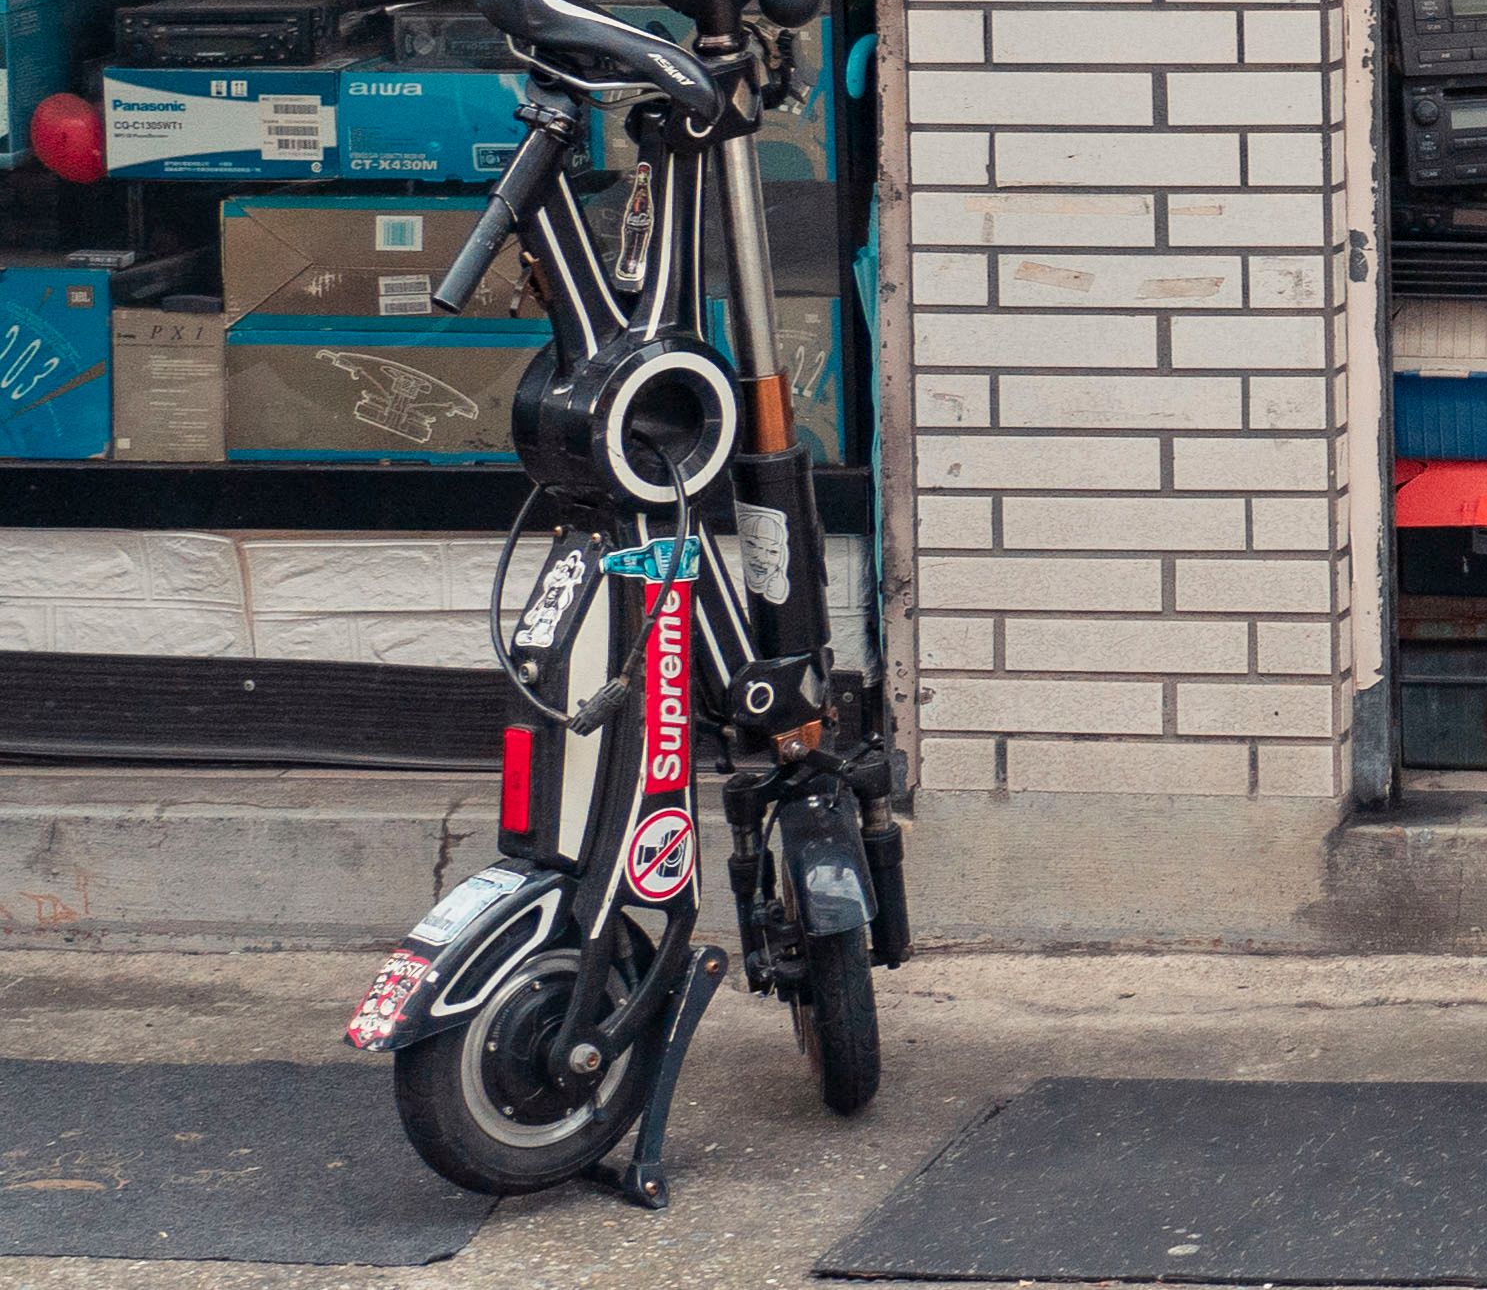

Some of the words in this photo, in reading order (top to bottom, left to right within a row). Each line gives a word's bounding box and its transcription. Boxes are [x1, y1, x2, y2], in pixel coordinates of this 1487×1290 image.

[347, 82, 423, 96] aiwa
[112, 100, 187, 112] Panasonic
[349, 159, 438, 171] CT-X430M
[652, 589, 681, 782] Supreme
